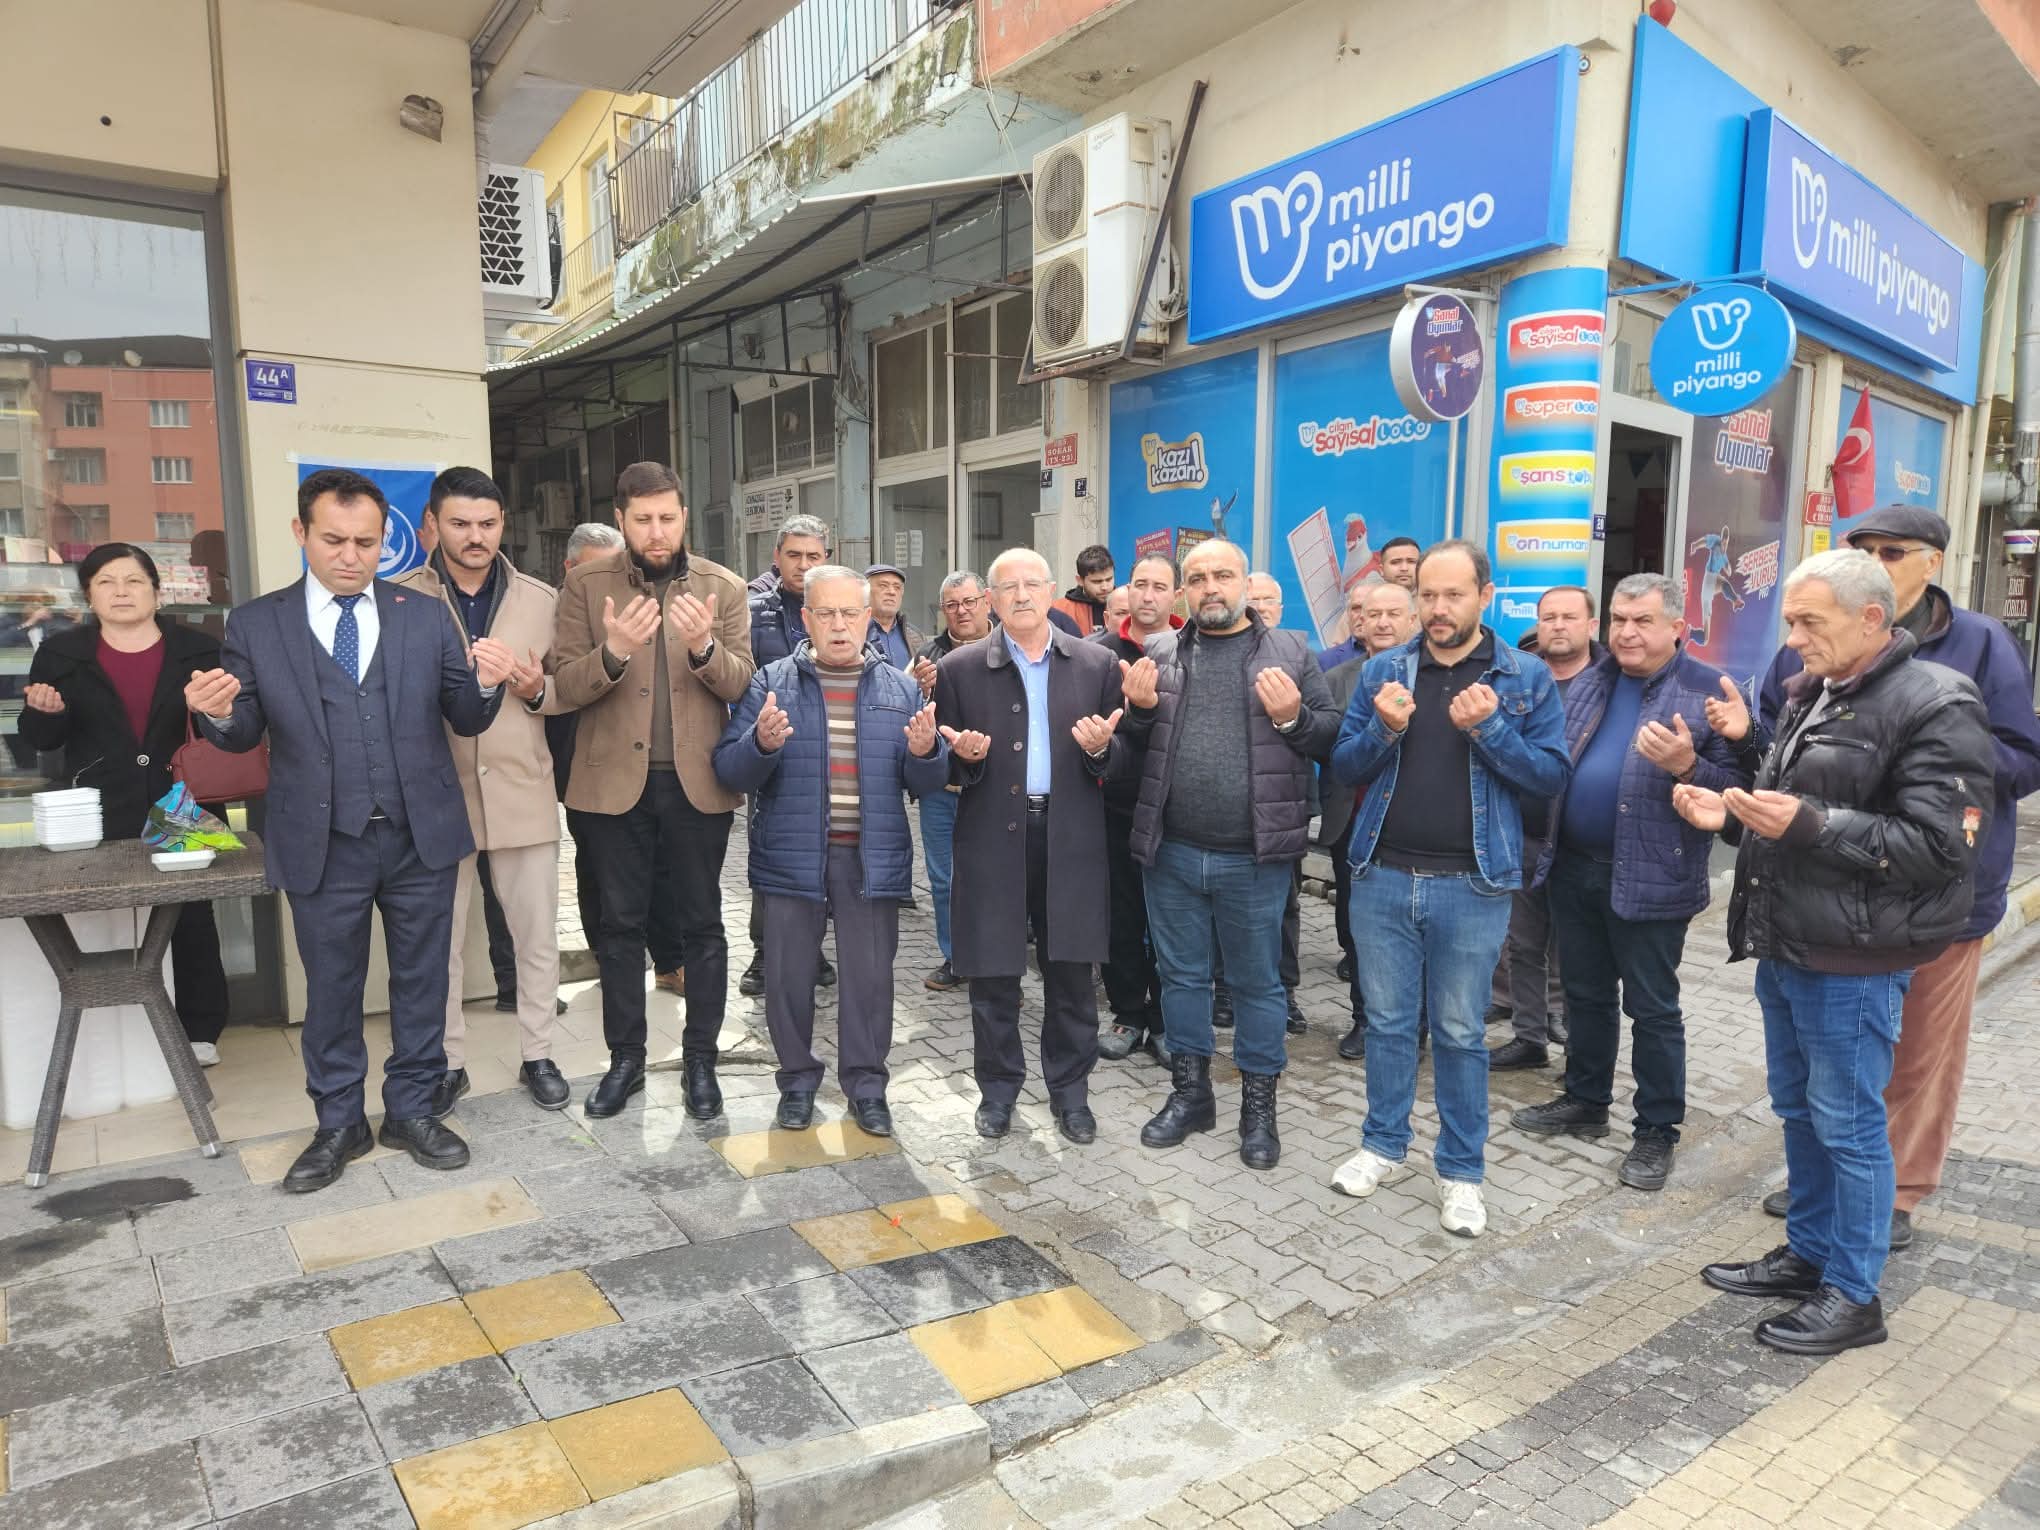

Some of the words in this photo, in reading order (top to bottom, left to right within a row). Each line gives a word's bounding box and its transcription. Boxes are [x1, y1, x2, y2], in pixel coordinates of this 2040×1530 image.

[1329, 157, 1412, 225] milli
[1326, 192, 1495, 283] piyango
[1828, 217, 1877, 287] milli
[1876, 243, 1950, 335] piyango
[1673, 370, 1762, 398] piyango
[1695, 352, 1741, 374] milli
[1729, 410, 1772, 441] Sanal
[1715, 431, 1773, 474] Oyunlar
